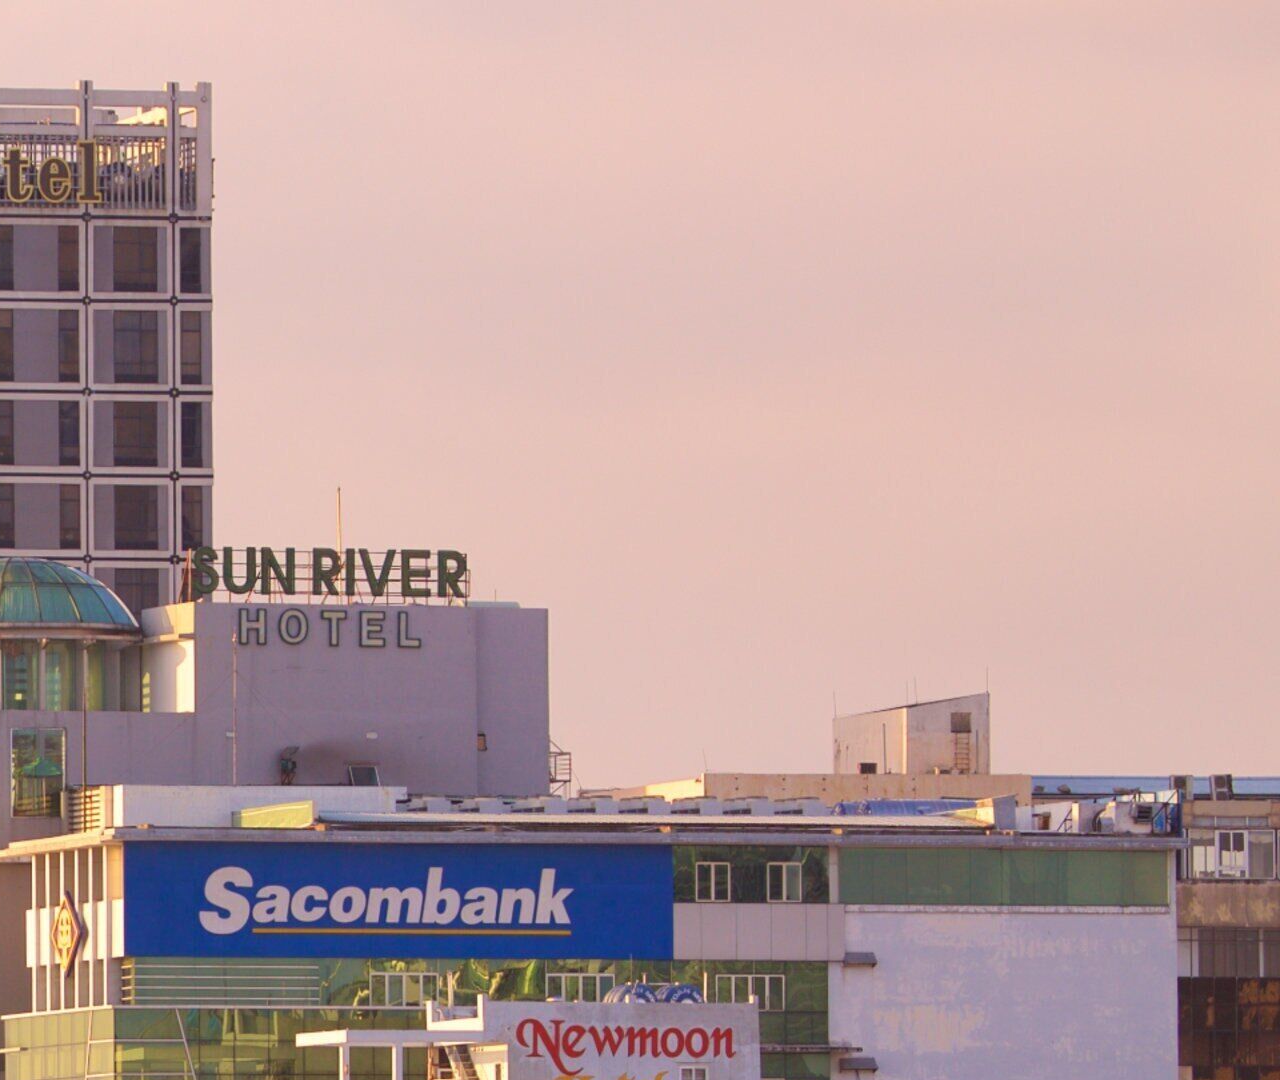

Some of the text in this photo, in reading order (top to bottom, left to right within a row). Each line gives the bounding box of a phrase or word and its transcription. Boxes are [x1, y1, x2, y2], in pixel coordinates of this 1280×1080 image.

[194, 546, 467, 597] SUN RIVER
[241, 608, 422, 648] HOTEL
[198, 866, 574, 935] Sacombank
[516, 1018, 736, 1075] Newmoon
